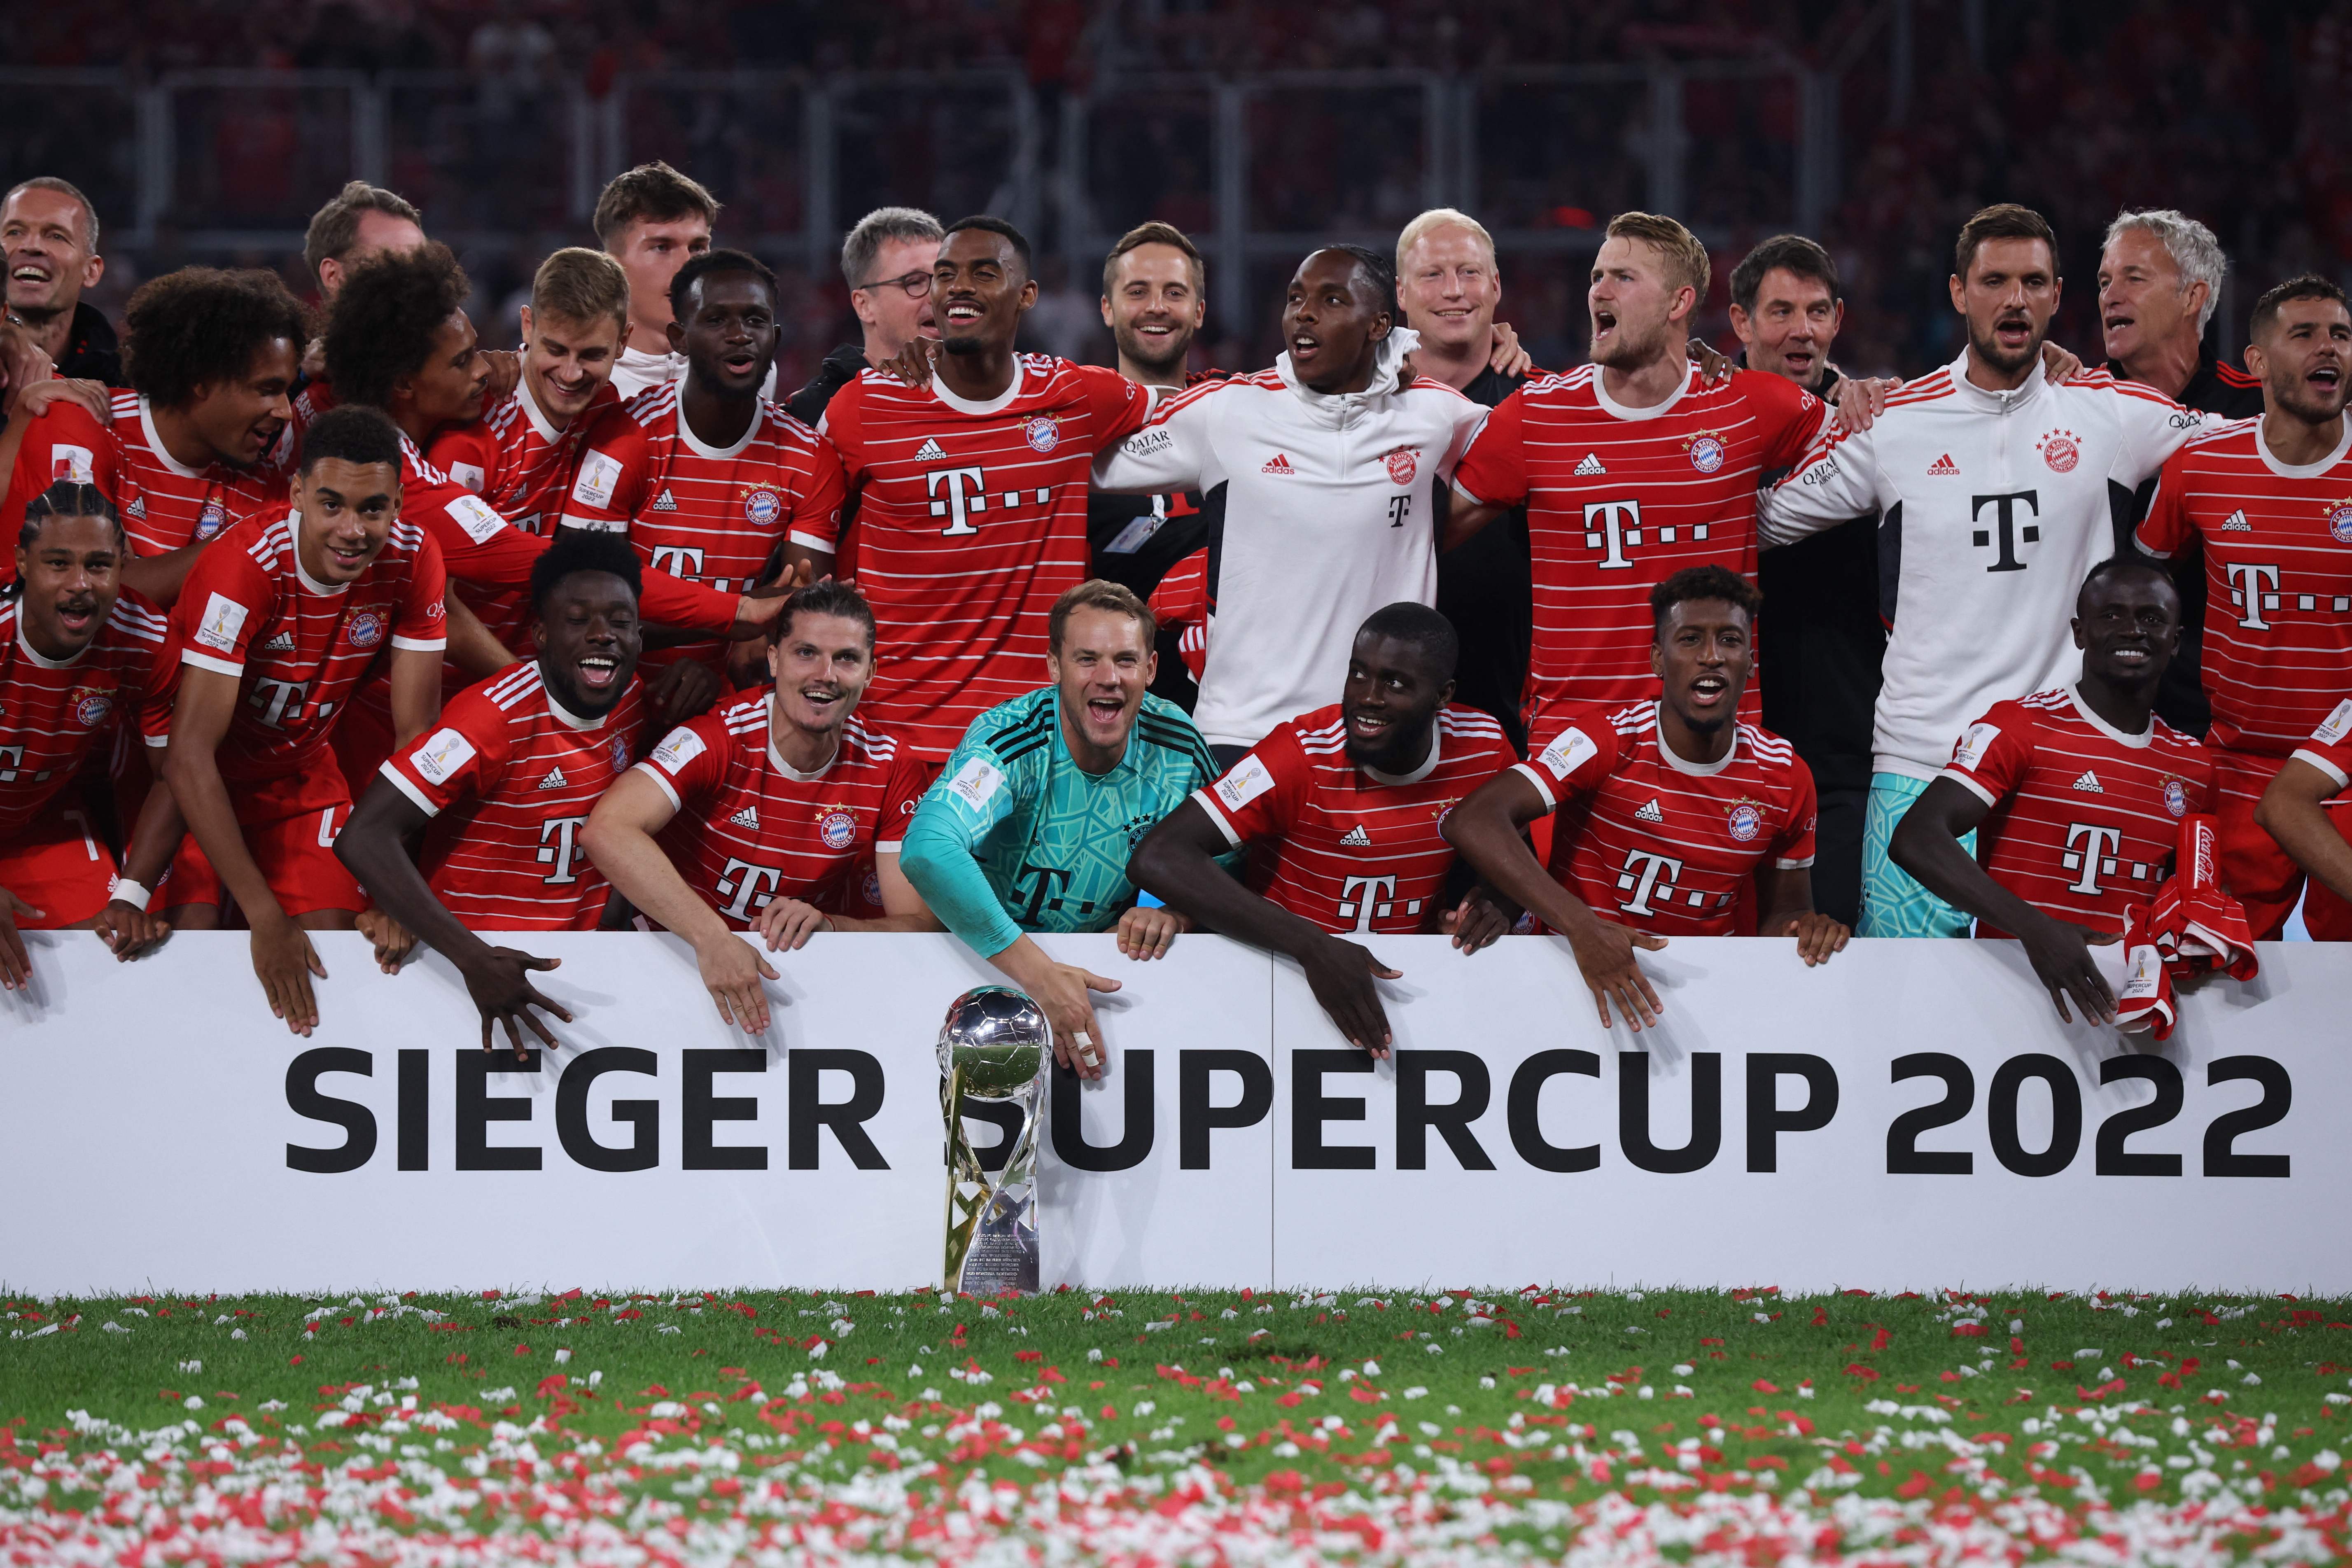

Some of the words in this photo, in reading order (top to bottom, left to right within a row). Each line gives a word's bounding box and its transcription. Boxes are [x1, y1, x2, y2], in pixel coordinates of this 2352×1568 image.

[1029, 426, 1034, 434] FC
[1033, 419, 1055, 431] BAYERN
[1124, 430, 1170, 453] QATAR
[1693, 447, 1699, 455] FC
[1698, 440, 1720, 452] BAYERN
[2046, 447, 2053, 455] FC
[2051, 440, 2074, 452] BAYERN
[1138, 440, 1173, 457] AIRWAYS
[914, 451, 947, 462] adidas
[1389, 459, 1395, 468] FC
[1394, 453, 1414, 465] BAYERN
[1261, 466, 1295, 475] adidas
[1574, 467, 1606, 476] adidas
[1927, 467, 1960, 476] adidas
[578, 486, 604, 499] SUPERCUP
[581, 494, 595, 502] 2022
[653, 502, 677, 511] adidas
[749, 497, 757, 506] FC
[757, 493, 778, 508] BAYERN
[2333, 514, 2340, 523] FC
[484, 523, 497, 534] 2022
[2221, 523, 2252, 532] adidas
[201, 631, 228, 646] SUPERCUP
[264, 641, 296, 651] adidas
[656, 755, 668, 763] 2022
[1545, 751, 1566, 769] SUPERCUP
[1546, 757, 1557, 767] 2022
[420, 754, 441, 777] SUPERCUP
[421, 763, 432, 775] 2022
[538, 779, 567, 789] adidas
[2072, 782, 2104, 794] adidas
[956, 782, 980, 802] SUPERCUP
[960, 789, 972, 799] 2022
[1635, 810, 1664, 822] adidas
[1732, 813, 1739, 821] FC
[1739, 808, 1759, 822] BAYERN
[730, 815, 760, 830] adidas
[824, 819, 832, 828] FC
[831, 816, 853, 829] BAYERN
[1339, 838, 1371, 846] adidas
[285, 1046, 892, 1174] SIEGER
[1886, 1052, 2292, 1178] 2022
